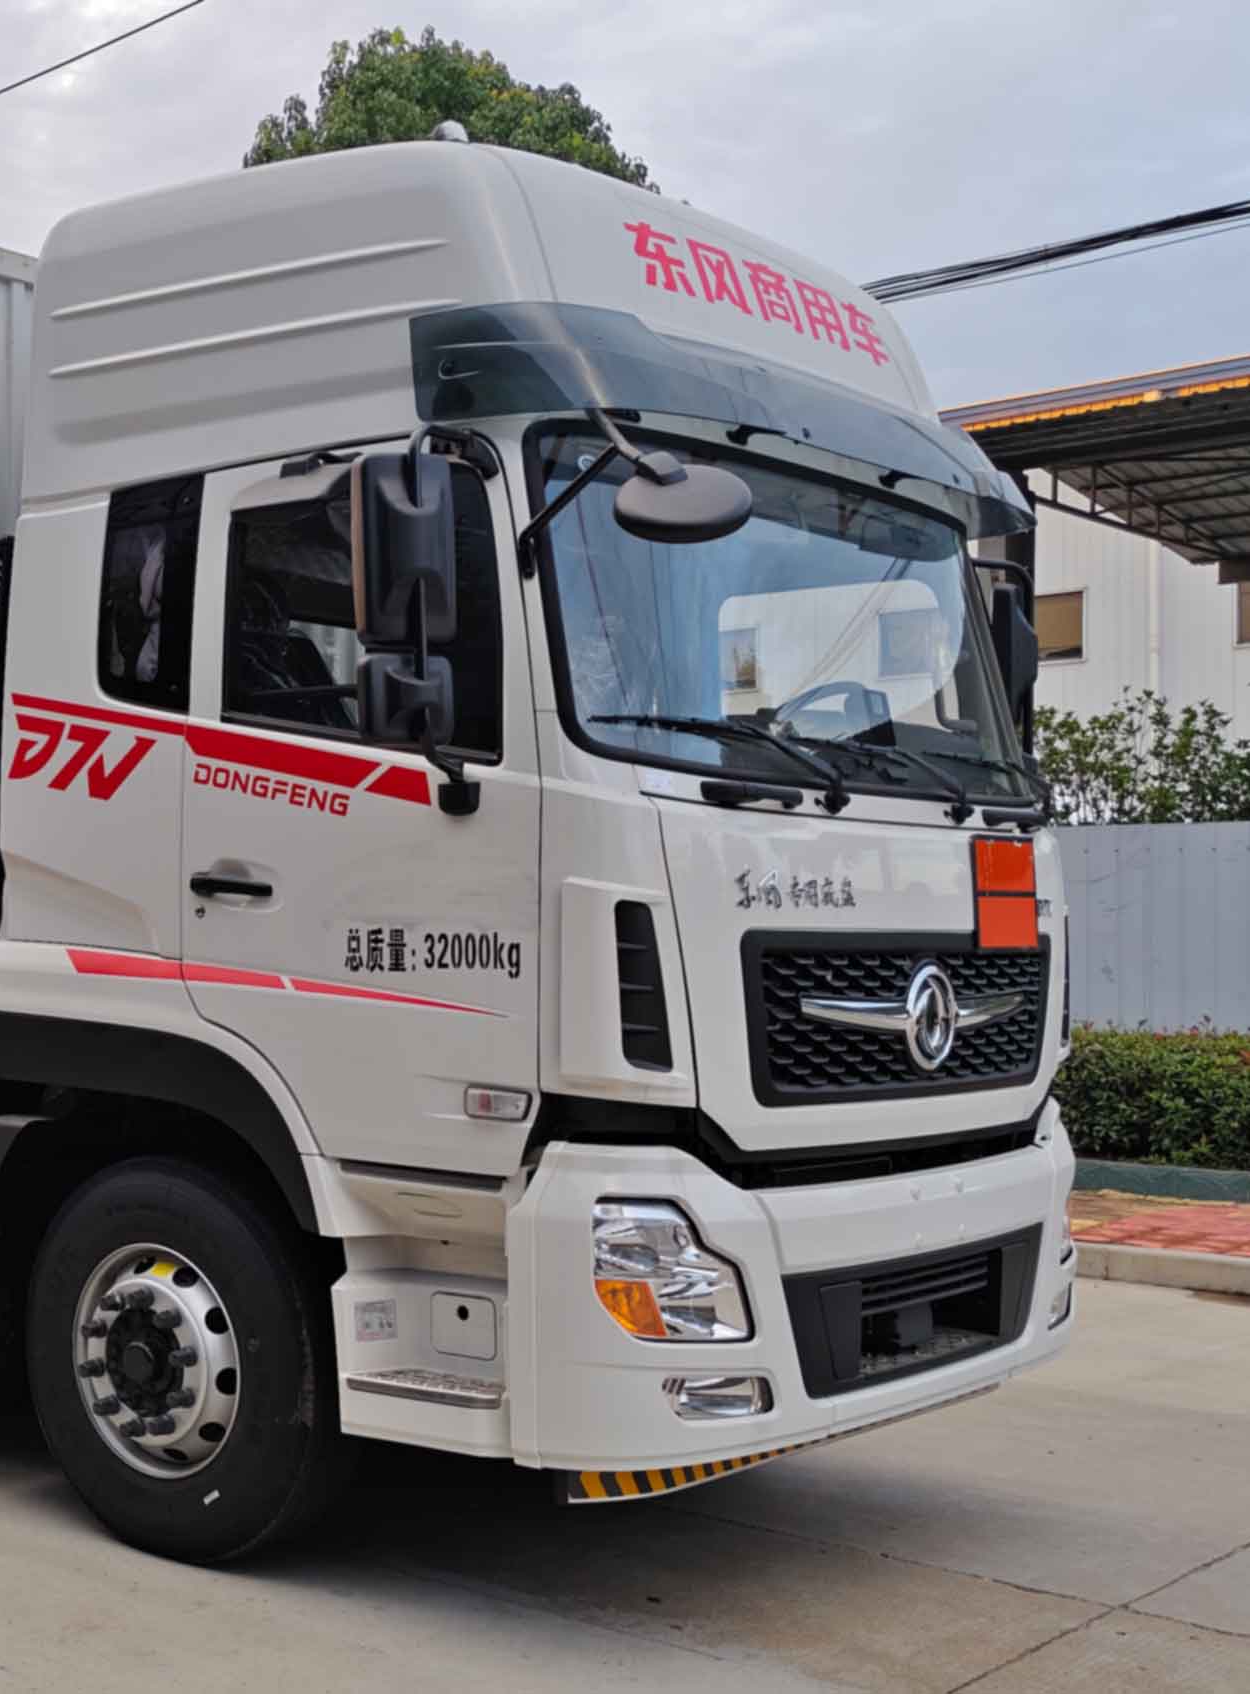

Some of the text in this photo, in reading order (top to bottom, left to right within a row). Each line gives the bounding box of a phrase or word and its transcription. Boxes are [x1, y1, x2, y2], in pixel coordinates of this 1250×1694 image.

[623, 221, 890, 366] 东风商用车
[193, 763, 350, 817] DONGFENG
